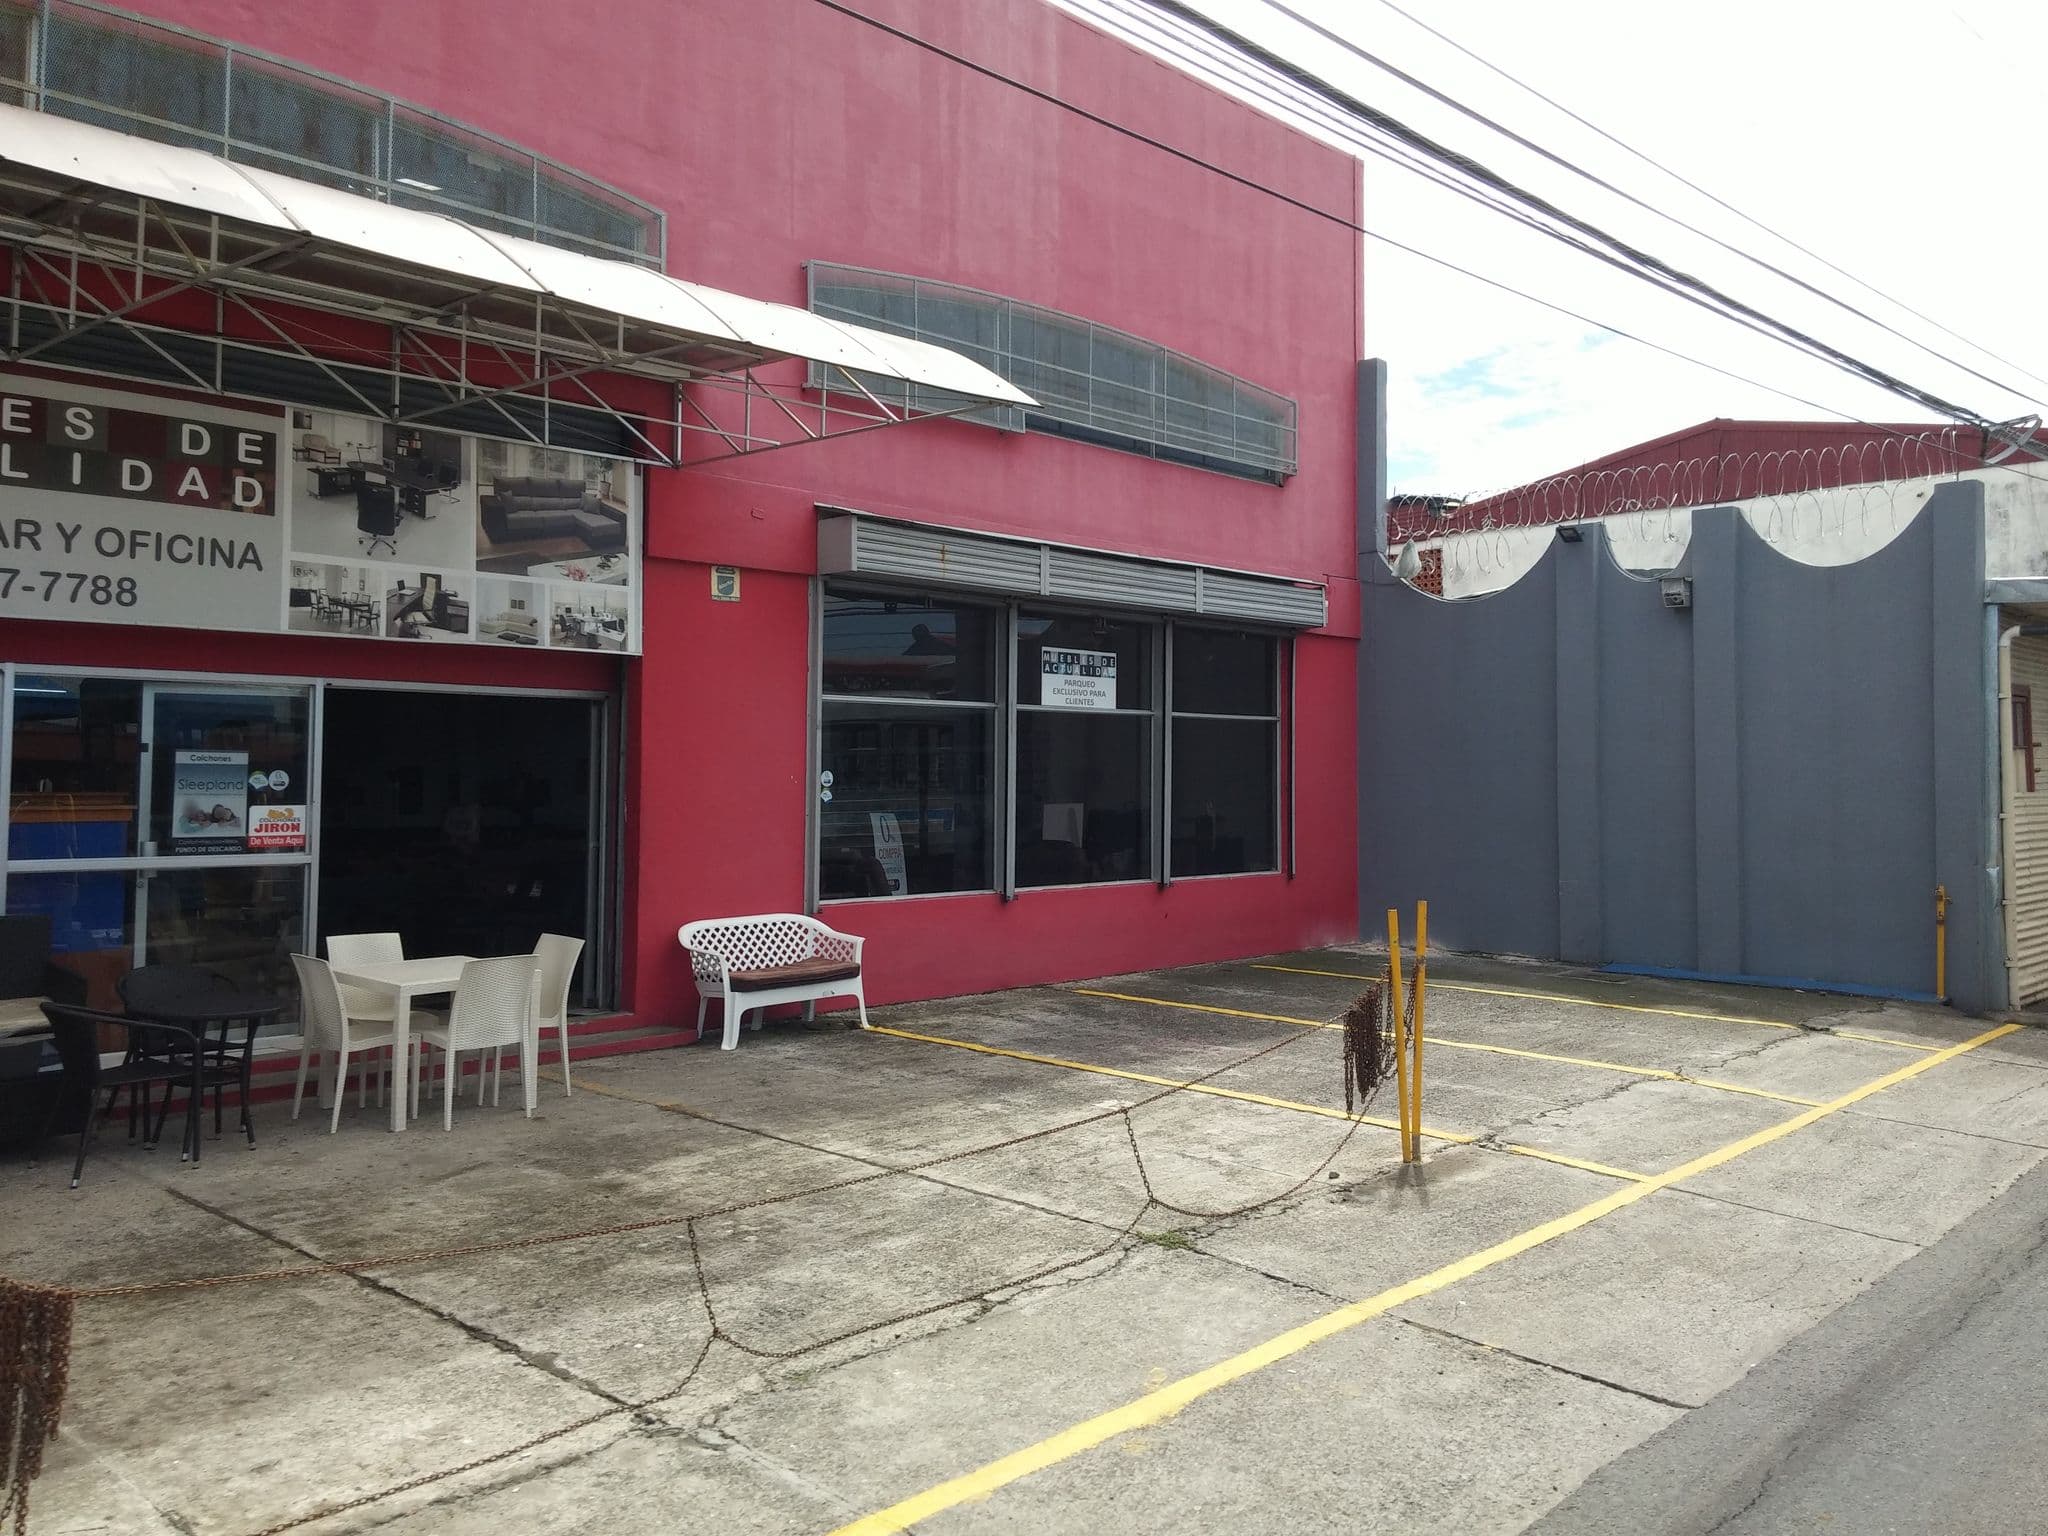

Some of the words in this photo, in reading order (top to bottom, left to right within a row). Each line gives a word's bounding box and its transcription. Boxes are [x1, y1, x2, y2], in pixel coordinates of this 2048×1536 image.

[181, 423, 263, 466] DE
[56, 522, 82, 554] Y
[95, 527, 263, 572] OFICINA
[0, 567, 137, 607] 7-7788
[1043, 652, 1094, 665] MUEBLES
[1102, 657, 1115, 667] DE
[1064, 679, 1096, 688] PARQUEO
[1052, 687, 1089, 697] EXCLUSIVO
[1089, 689, 1107, 698] PARA
[1065, 697, 1095, 706] CLIENTES
[190, 754, 231, 762] Colchones
[177, 777, 244, 792] Sleepland
[254, 823, 300, 833] JIRON
[250, 837, 261, 846] De
[262, 837, 284, 845] Venta
